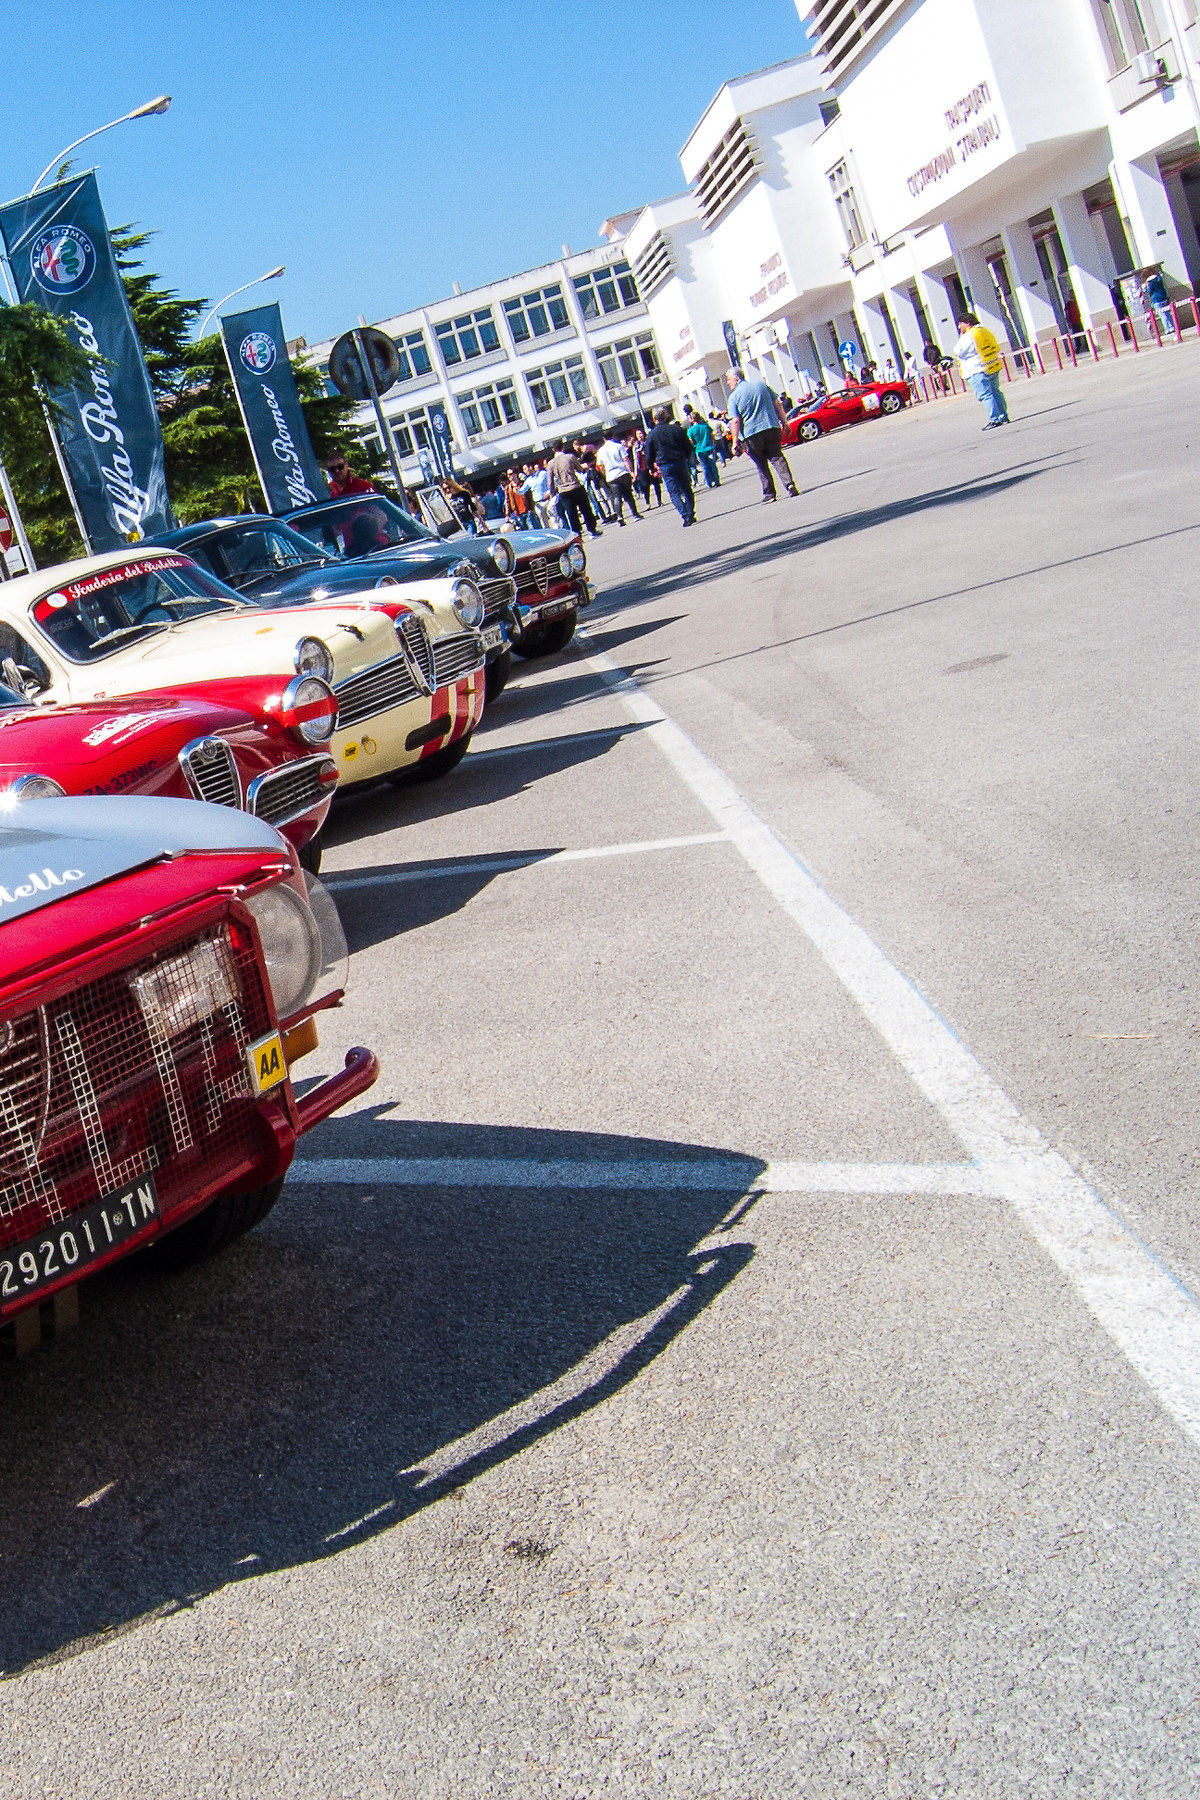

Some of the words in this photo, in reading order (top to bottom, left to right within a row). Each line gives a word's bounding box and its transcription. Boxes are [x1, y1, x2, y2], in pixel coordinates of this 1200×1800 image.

[261, 384, 299, 463] Romeo
[102, 446, 150, 539] Alfa
[68, 572, 125, 599] Scuderia
[124, 565, 143, 580] del
[259, 1047, 280, 1081] AA
[120, 1182, 155, 1228] TN
